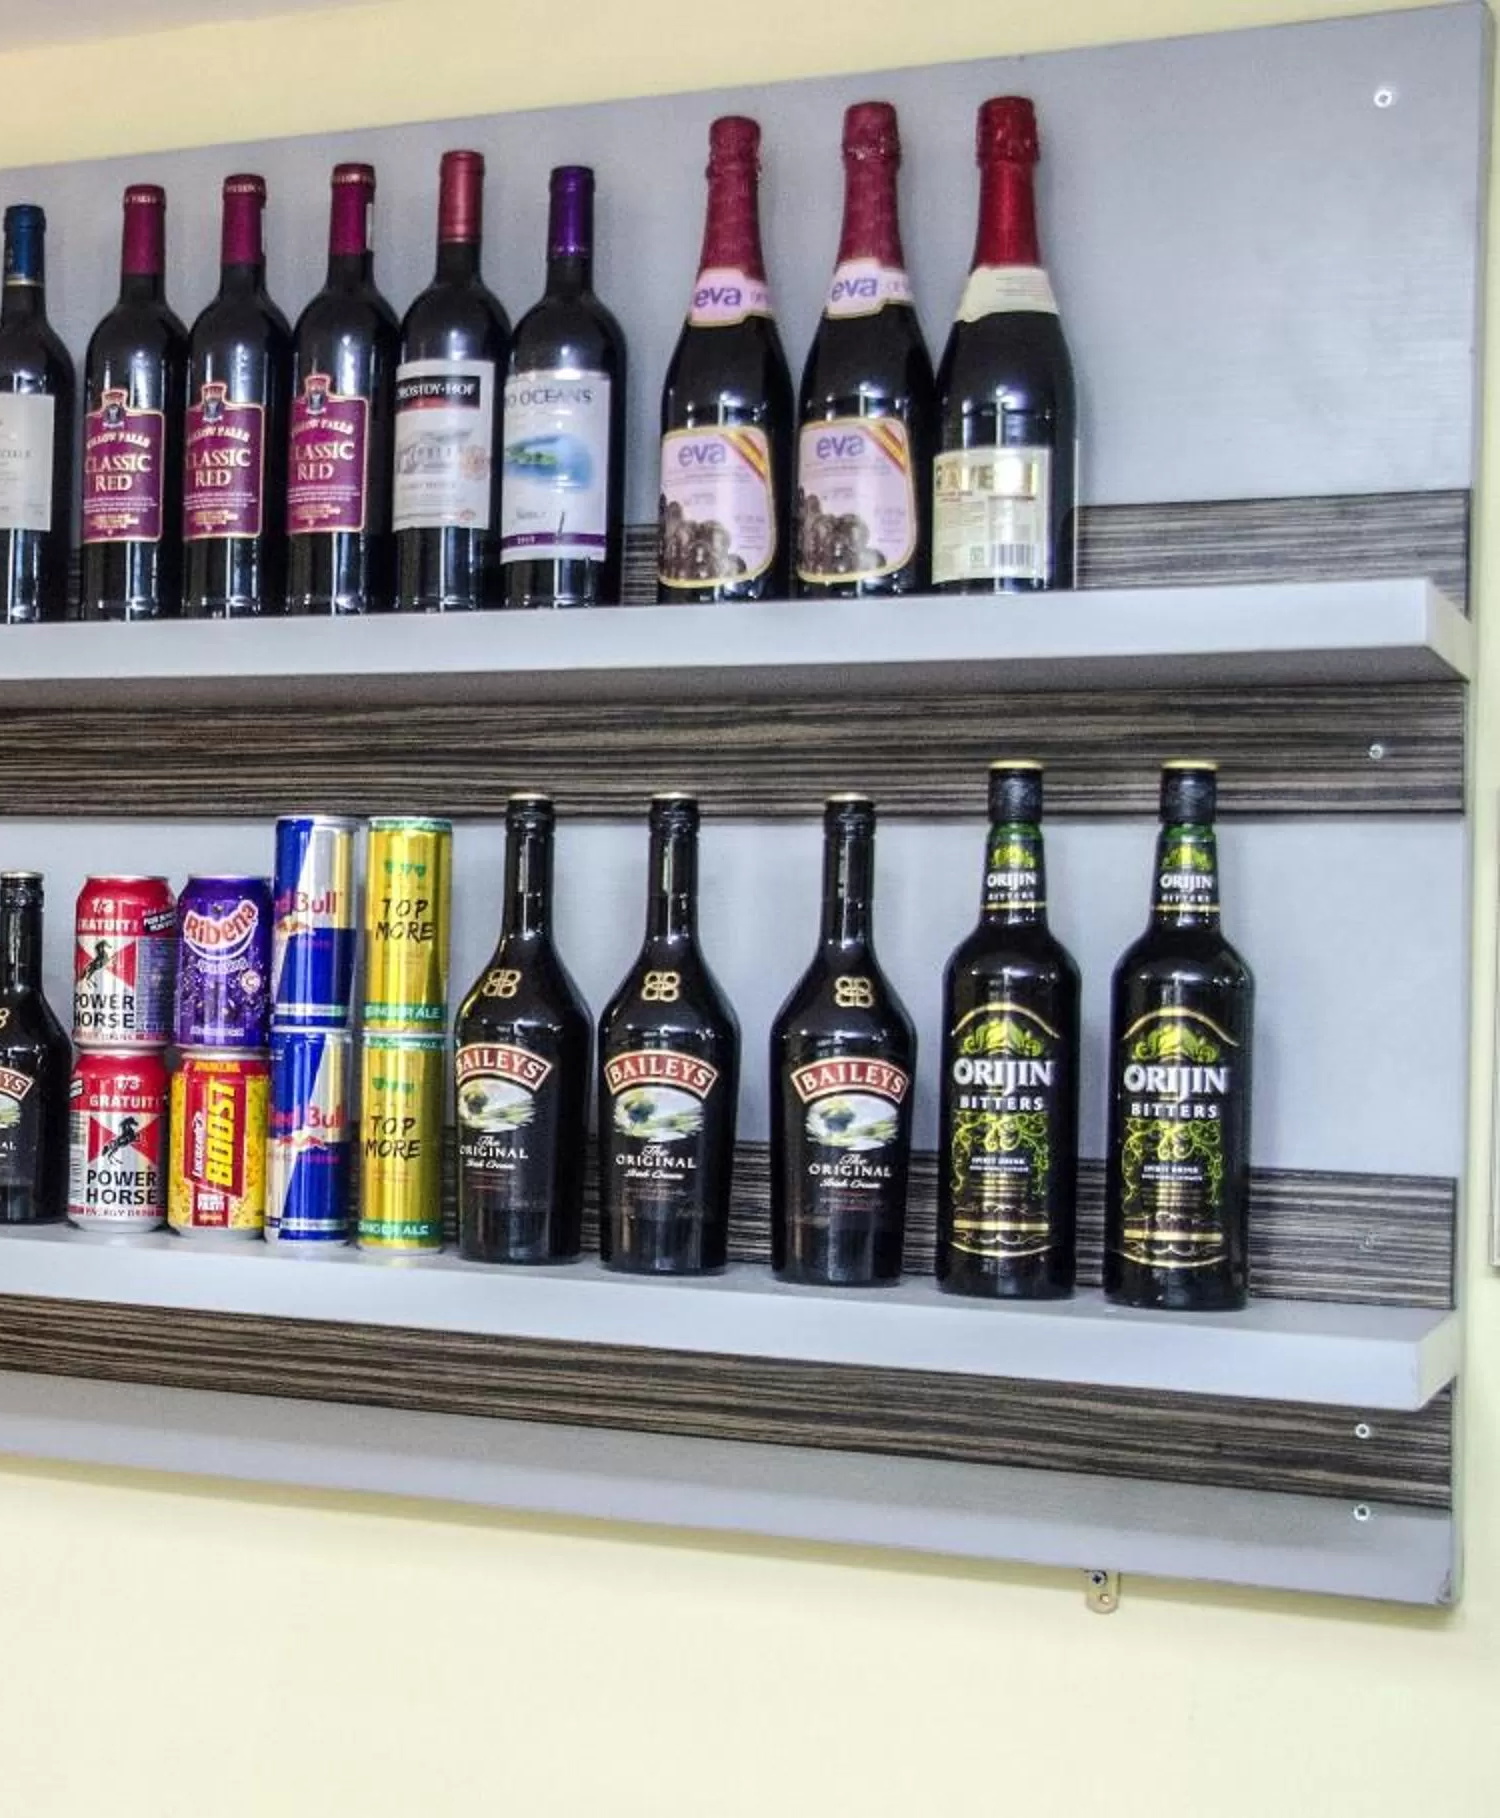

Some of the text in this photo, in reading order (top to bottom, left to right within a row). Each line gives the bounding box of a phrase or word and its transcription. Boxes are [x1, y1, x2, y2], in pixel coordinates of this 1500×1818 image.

[694, 286, 743, 308] eva
[831, 276, 879, 302] eva
[677, 440, 726, 468] eva
[816, 433, 866, 461] eva
[85, 453, 152, 473] CLASSIC
[297, 463, 335, 481] RED
[95, 474, 133, 492] RED
[195, 470, 232, 488] RED
[987, 871, 1037, 890] ORIJIN
[1160, 873, 1213, 893] ORIJIN
[296, 890, 338, 914] Bull
[381, 898, 429, 919] TOP
[186, 902, 257, 945] Ribena
[375, 920, 436, 943] MORE
[73, 1012, 135, 1029] HORSE
[415, 1007, 441, 1019] ALE
[610, 1052, 711, 1086] BAILEYS
[801, 1061, 905, 1094] BAILEYS
[953, 1059, 1055, 1097] ORIJIN
[1123, 1065, 1230, 1102] ORIJIN
[90, 1095, 153, 1108] GRATUIT
[959, 1094, 1045, 1112] BITTERS
[1131, 1102, 1219, 1119] BITTERS
[371, 1115, 417, 1136] TOP
[365, 1139, 421, 1163] MORE
[459, 1145, 529, 1160] ORIGINAL
[615, 1153, 697, 1169] ORIGINAL
[86, 1169, 157, 1187] POWER
[808, 1163, 892, 1178] ORIGINAL
[85, 1188, 158, 1205] HORSE
[403, 1223, 429, 1236] ALE
